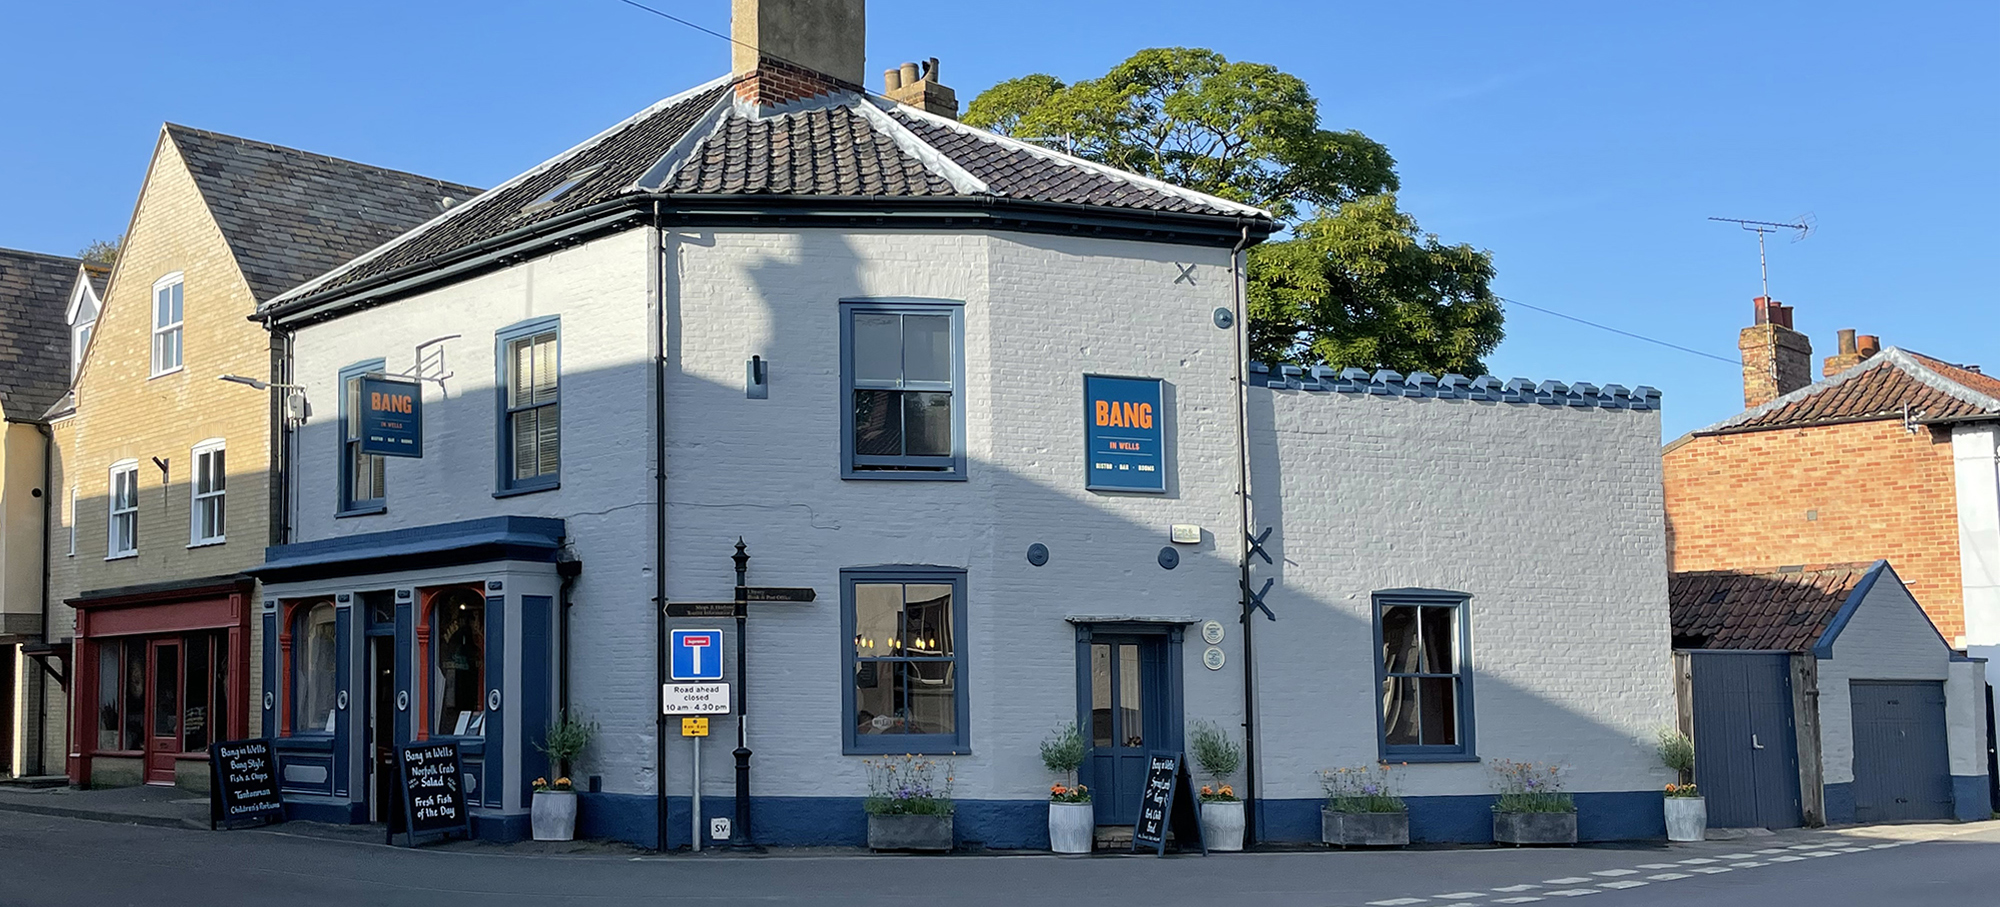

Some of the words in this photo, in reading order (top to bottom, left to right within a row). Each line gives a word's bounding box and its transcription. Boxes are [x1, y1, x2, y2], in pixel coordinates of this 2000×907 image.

[371, 392, 412, 414] BANG
[1096, 400, 1152, 429] BANG
[1110, 441, 1117, 449] IN
[1119, 442, 1140, 450] WELLS
[221, 747, 240, 760] Bang
[240, 746, 246, 754] in
[246, 745, 266, 754] Wells
[405, 750, 423, 765] Bang
[425, 749, 432, 759] in
[432, 746, 453, 758] Wells
[230, 760, 247, 772] Bang
[248, 758, 264, 771] Style
[411, 764, 438, 779] Norfolk
[439, 762, 455, 774] Crab
[230, 774, 244, 782] Fish
[251, 773, 268, 783] Chips
[421, 775, 444, 787] Salad
[415, 795, 434, 807] Fresh
[436, 794, 452, 804] Fish
[231, 803, 259, 814] Children's
[417, 808, 424, 820] of
[425, 807, 438, 817] the
[440, 805, 455, 819] Day
[715, 824, 726, 832] SV
